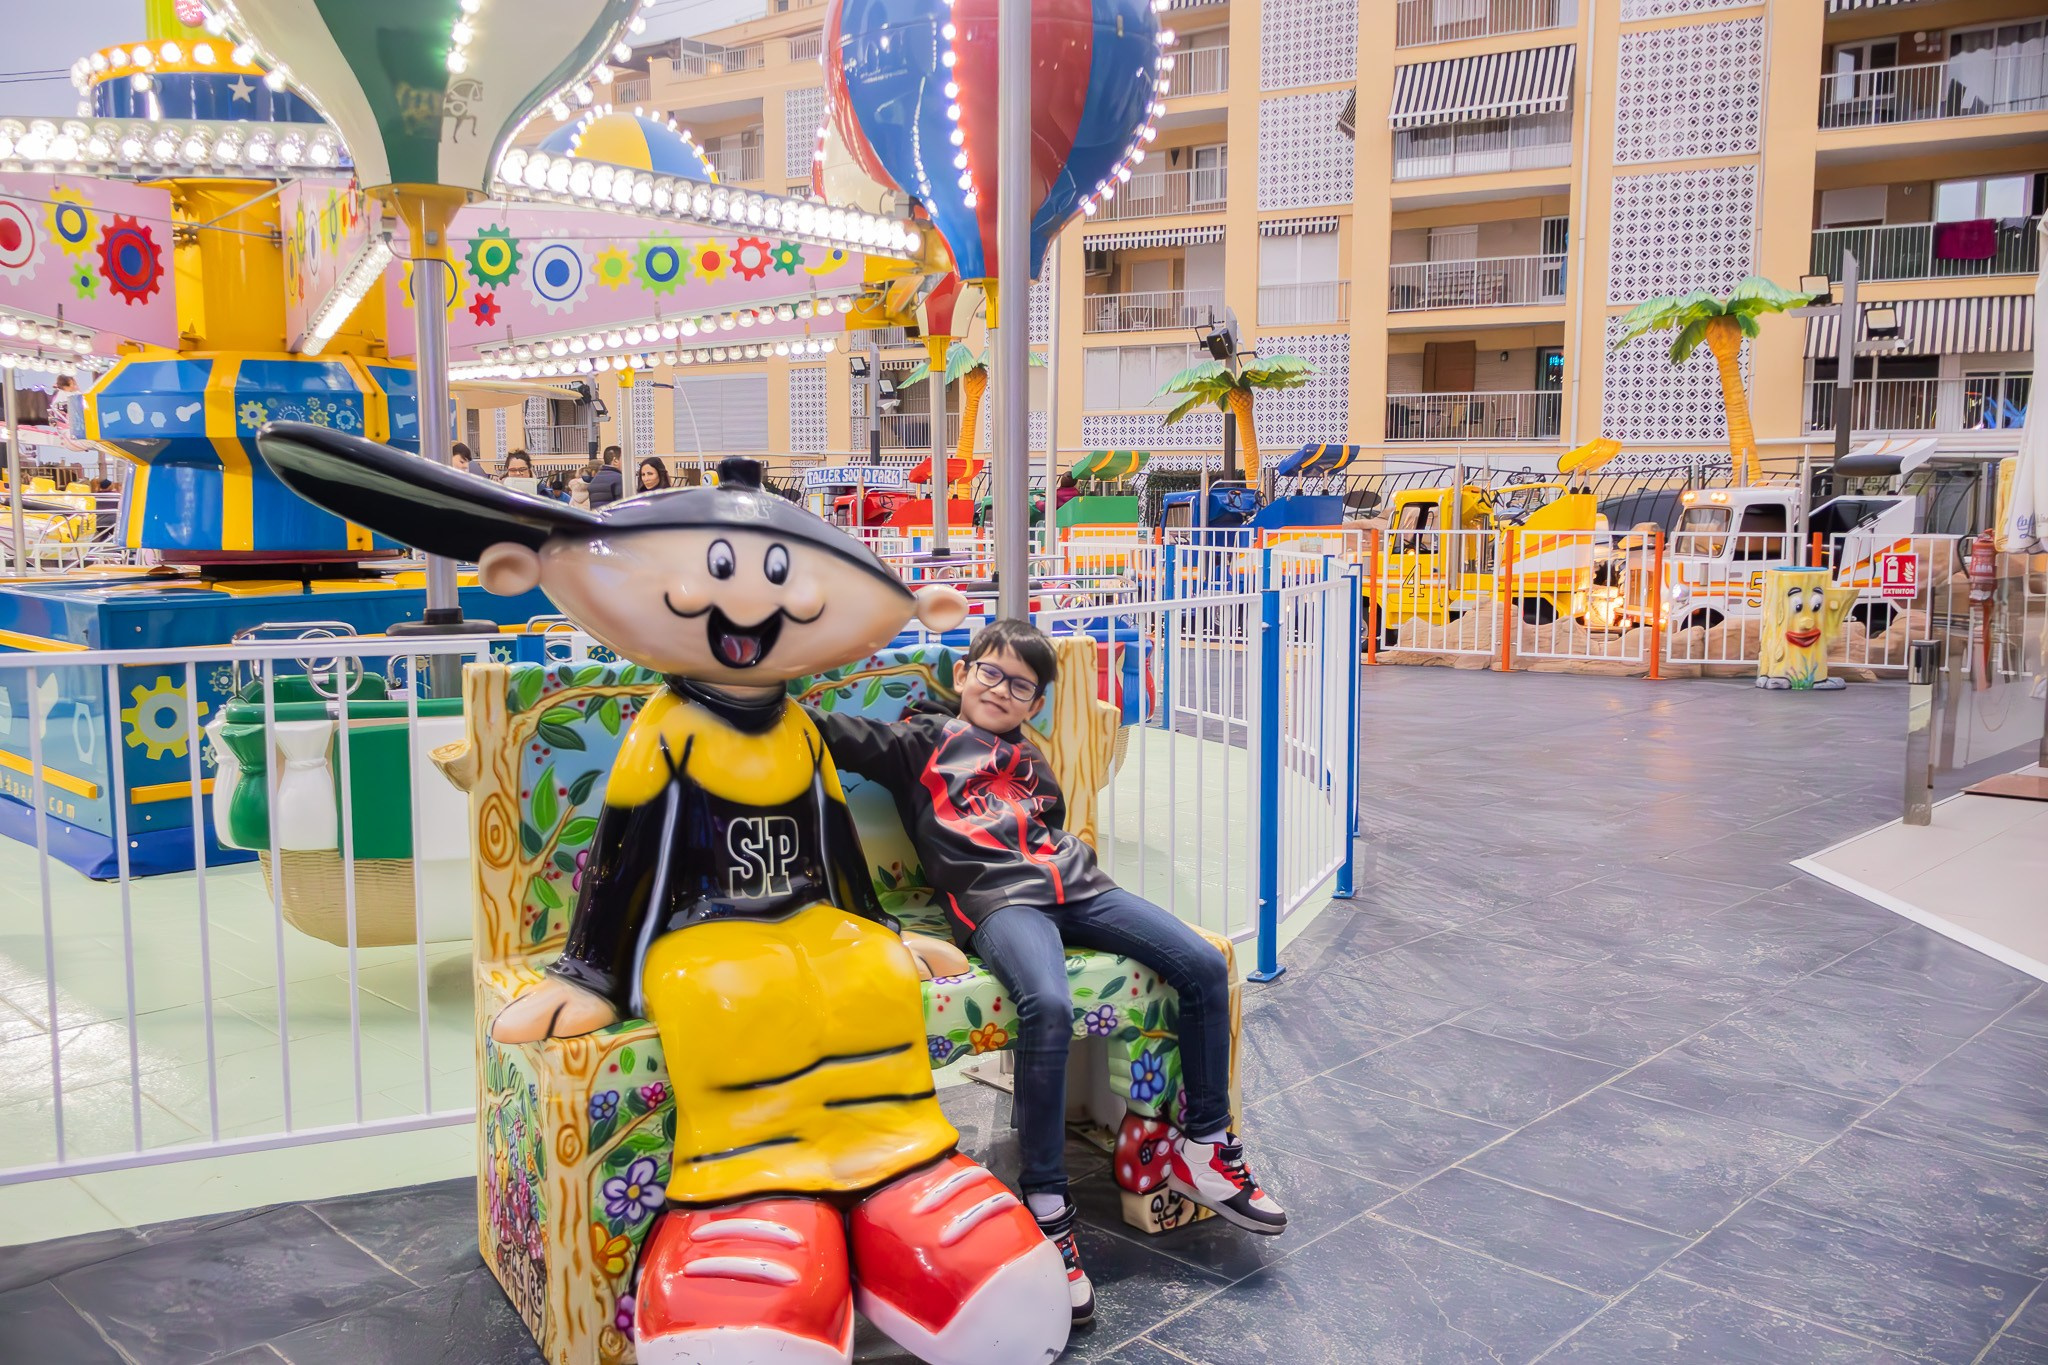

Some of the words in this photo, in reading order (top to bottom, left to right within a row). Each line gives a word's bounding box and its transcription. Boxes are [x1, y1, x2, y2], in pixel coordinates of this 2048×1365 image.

[807, 469, 841, 485] TALLER
[842, 468, 871, 482] SOUD
[873, 469, 899, 484] PARK
[1402, 563, 1425, 598] 4
[1747, 570, 1767, 608] 5
[727, 816, 799, 899] SP
